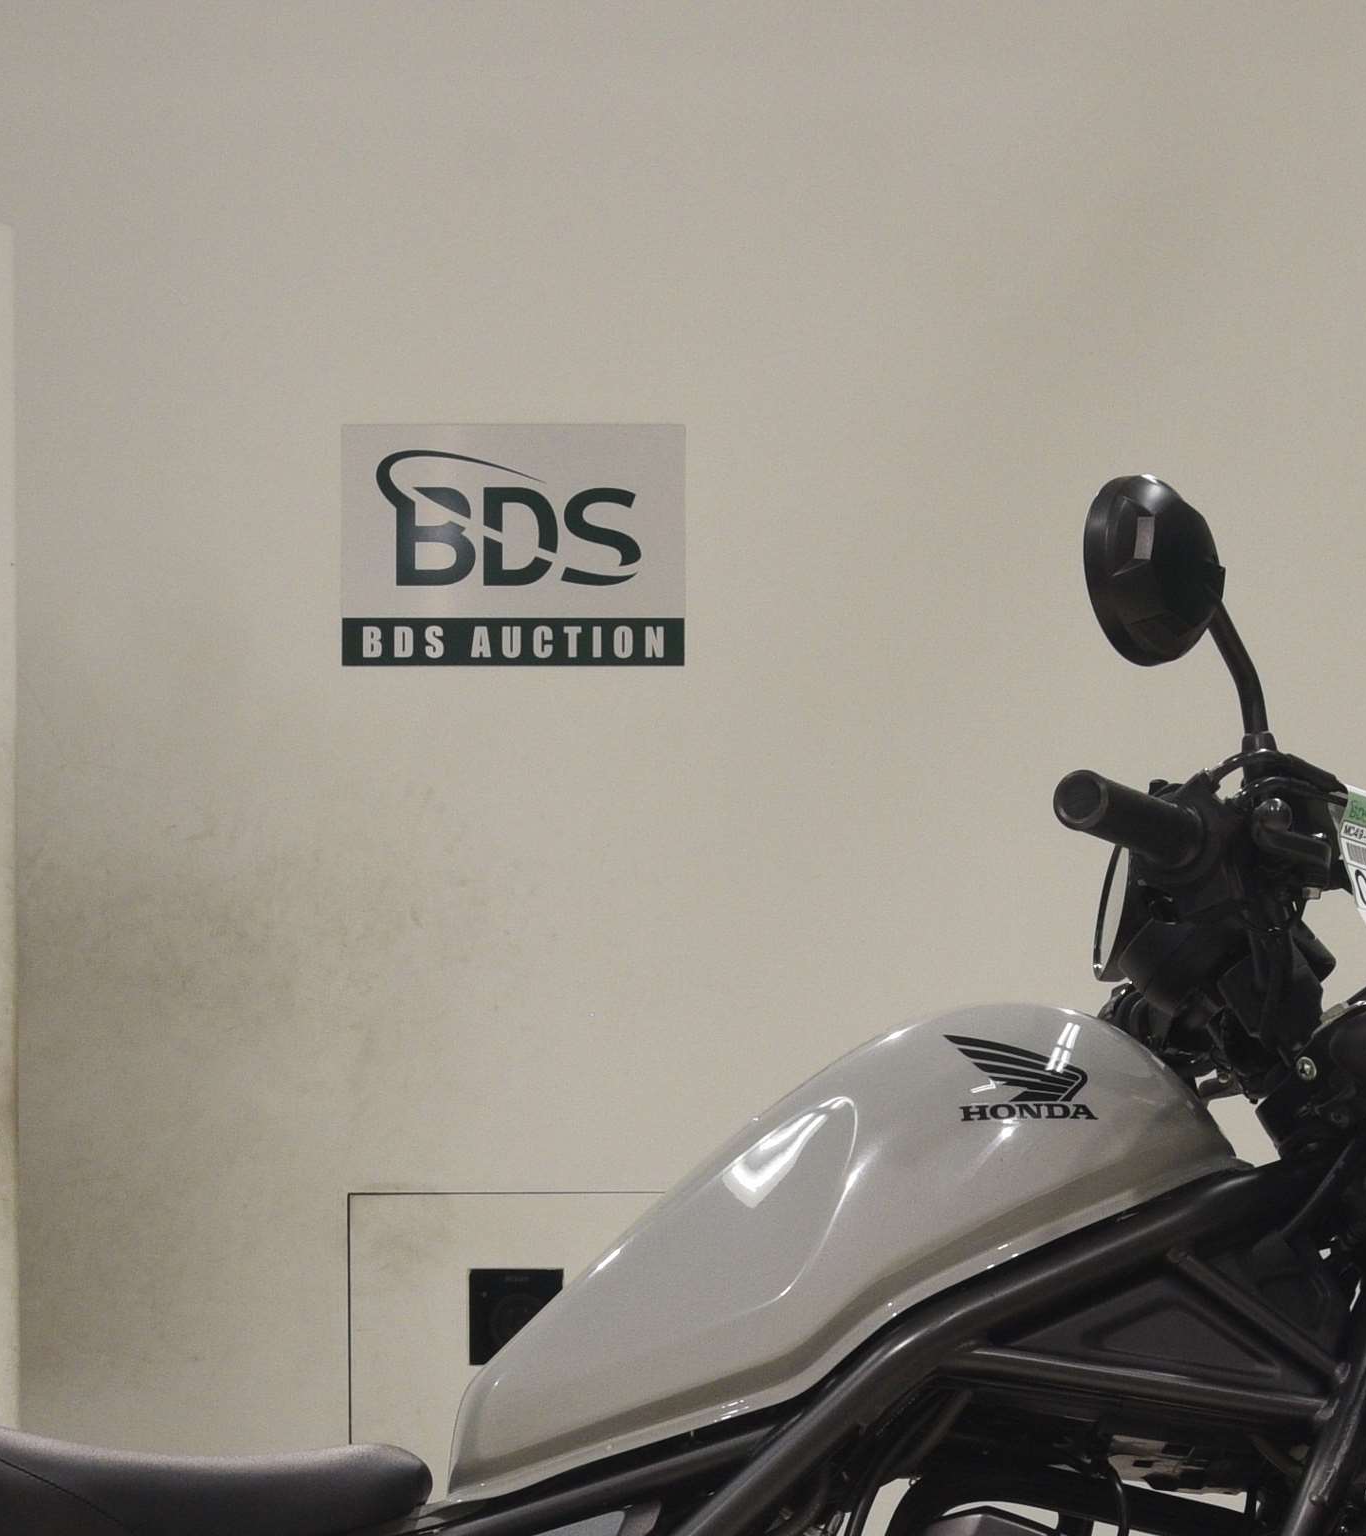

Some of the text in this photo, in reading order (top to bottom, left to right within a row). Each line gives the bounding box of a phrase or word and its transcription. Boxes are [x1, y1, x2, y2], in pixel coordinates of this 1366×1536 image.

[376, 449, 642, 586] BDS
[362, 625, 665, 659] BDS AUCTION
[958, 1103, 1099, 1122] HONDA
